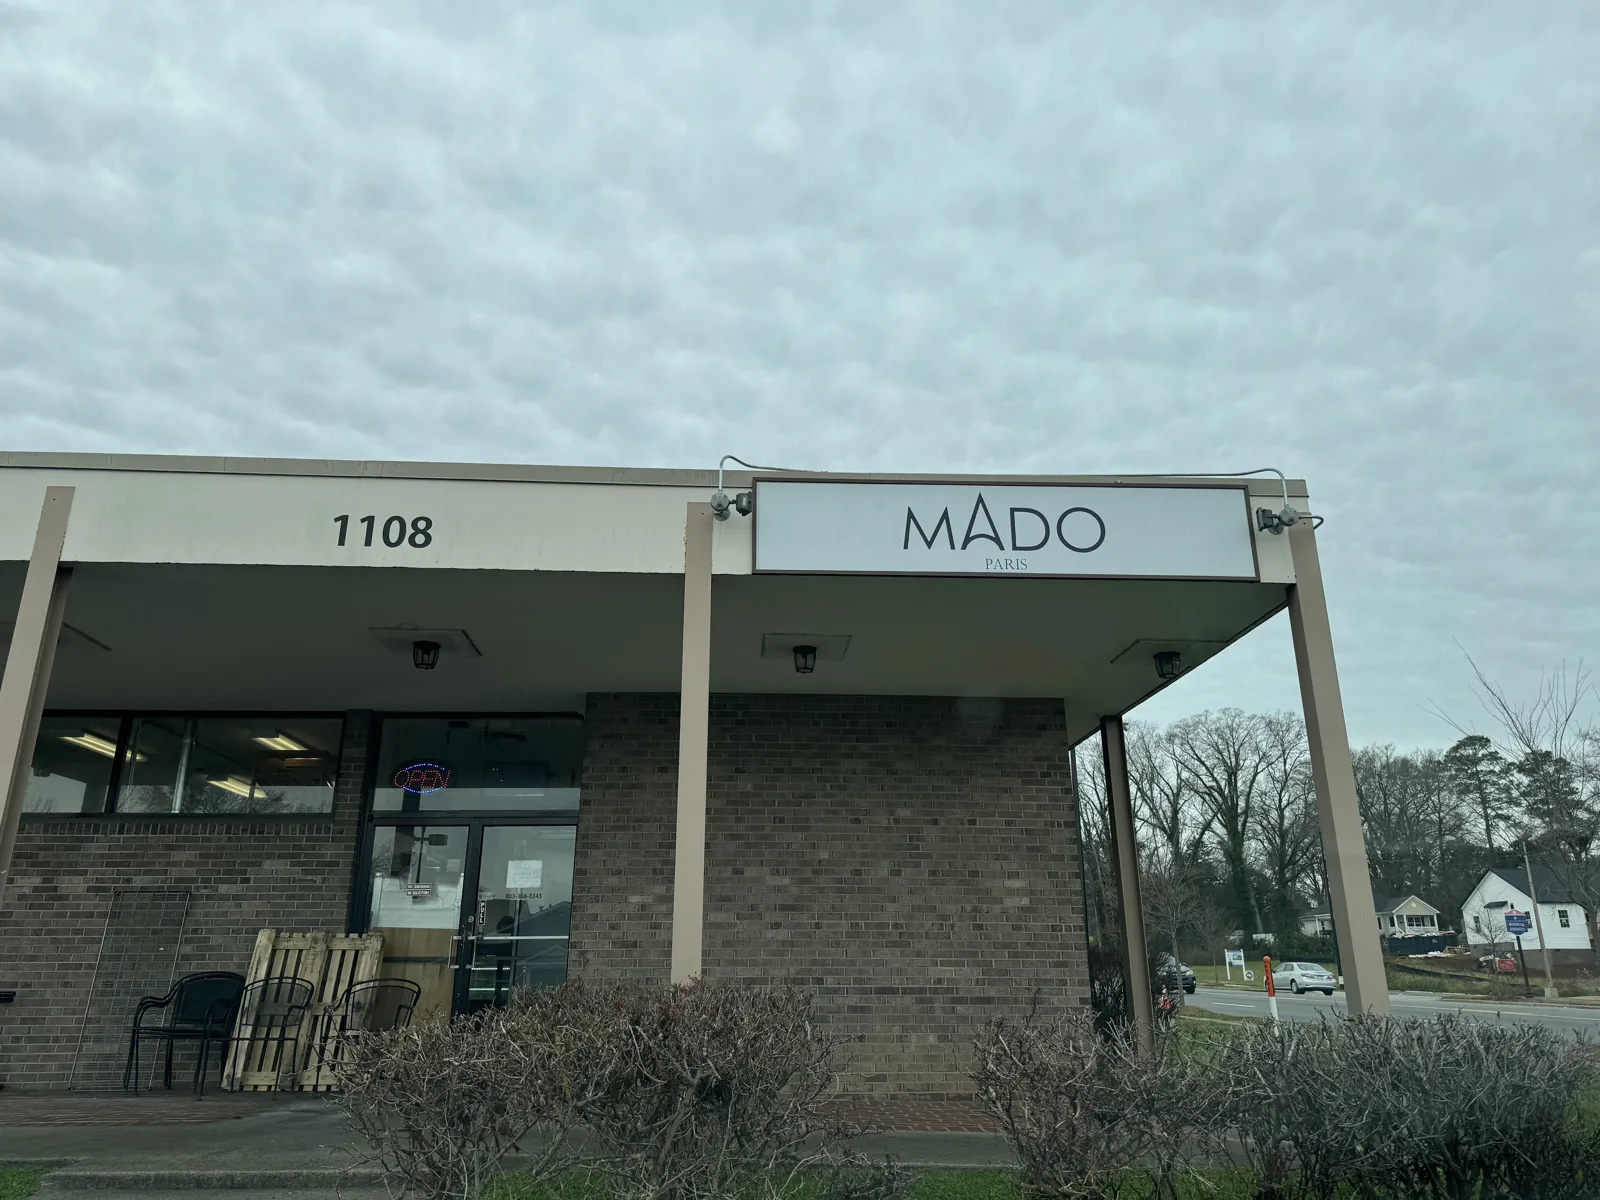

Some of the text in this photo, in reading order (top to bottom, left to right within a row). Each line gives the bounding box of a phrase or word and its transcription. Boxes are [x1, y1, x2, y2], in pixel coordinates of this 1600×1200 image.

[333, 514, 433, 549] 1108
[903, 491, 1106, 553] MADO
[985, 558, 1028, 571] PARIS
[393, 769, 451, 789] OPEN
